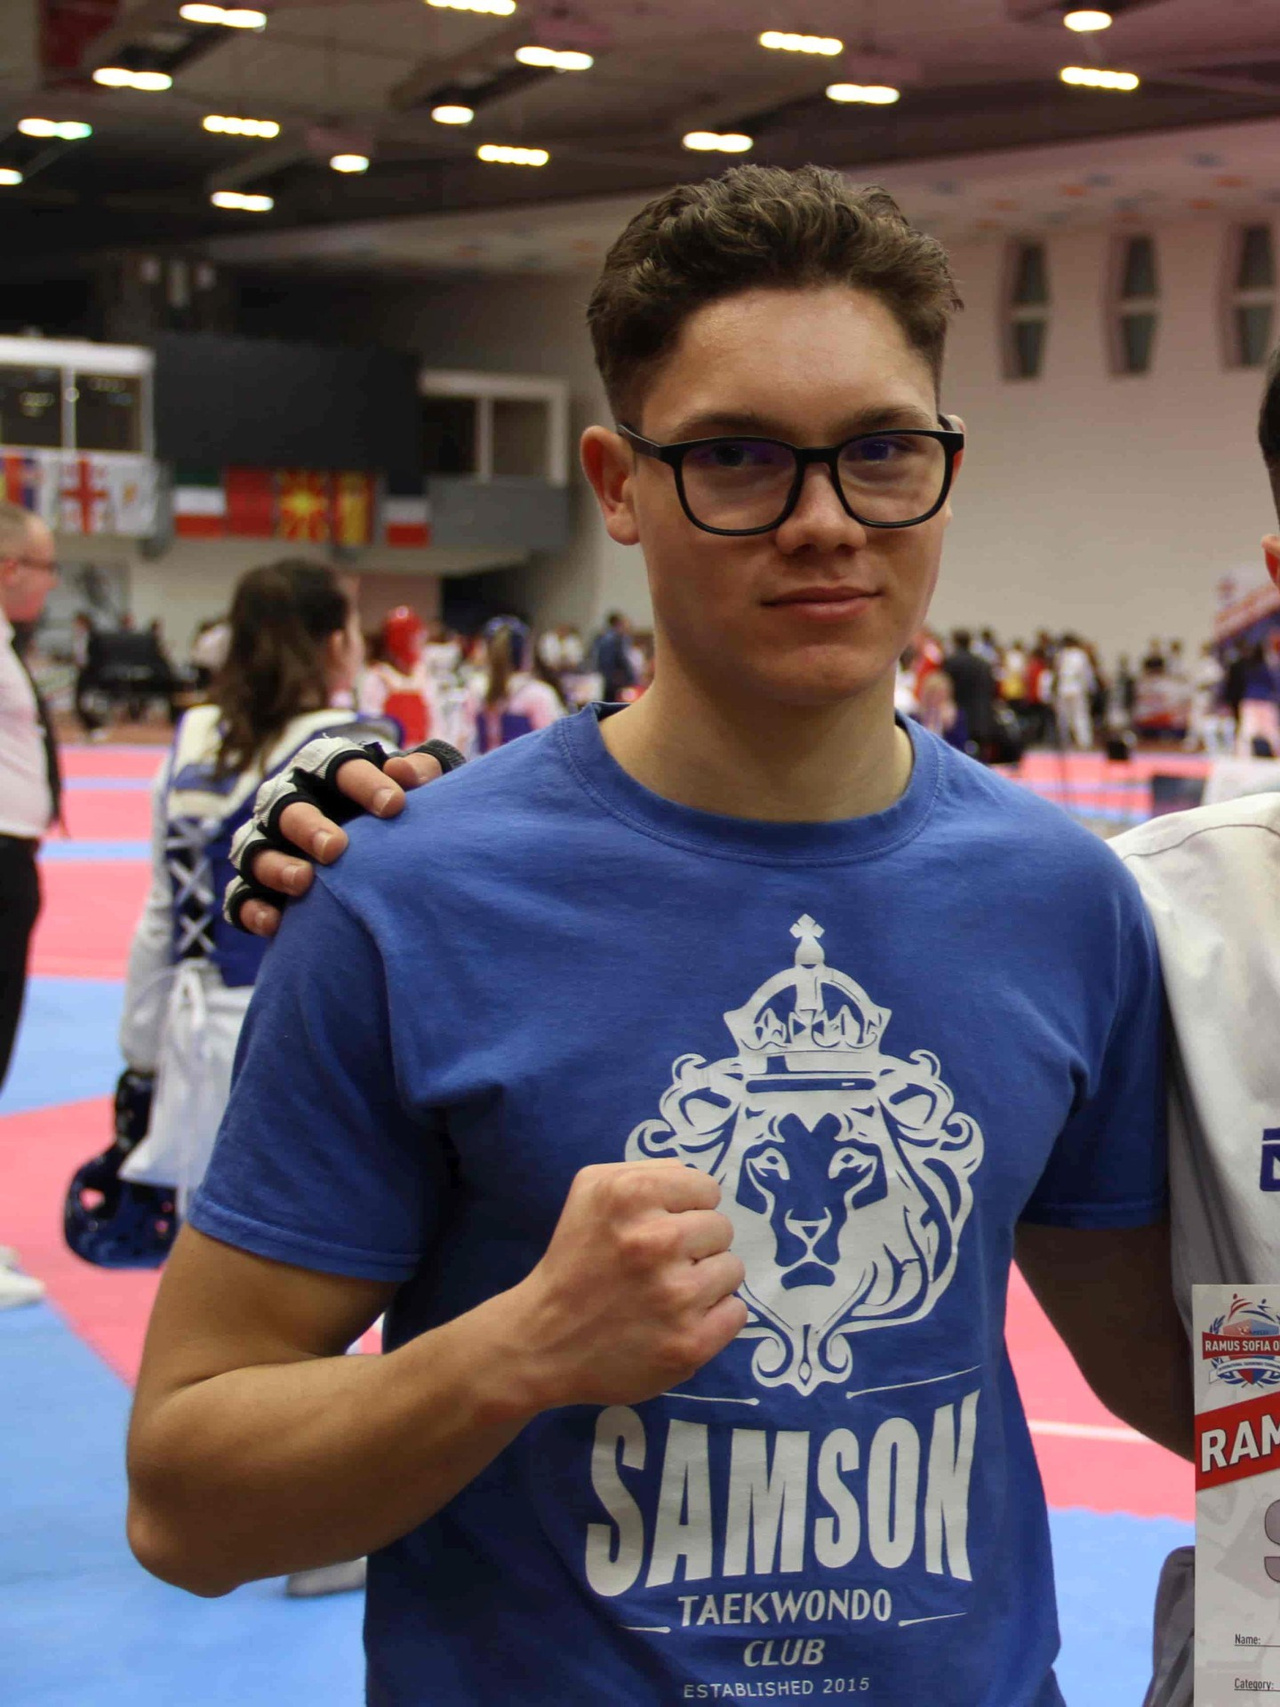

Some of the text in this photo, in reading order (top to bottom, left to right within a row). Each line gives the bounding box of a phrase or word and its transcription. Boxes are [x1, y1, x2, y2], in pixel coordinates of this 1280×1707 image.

[1205, 1340, 1240, 1352] RAMUS
[1242, 1340, 1271, 1352] SOFIA
[585, 1389, 981, 1597] SAMSON
[678, 1588, 893, 1627] TAEKWONDO
[1234, 1633, 1262, 1646] Name:
[743, 1638, 826, 1667] CLUB
[683, 1677, 870, 1699] ESTABLISHED 2015
[1234, 1677, 1275, 1691] Category:
